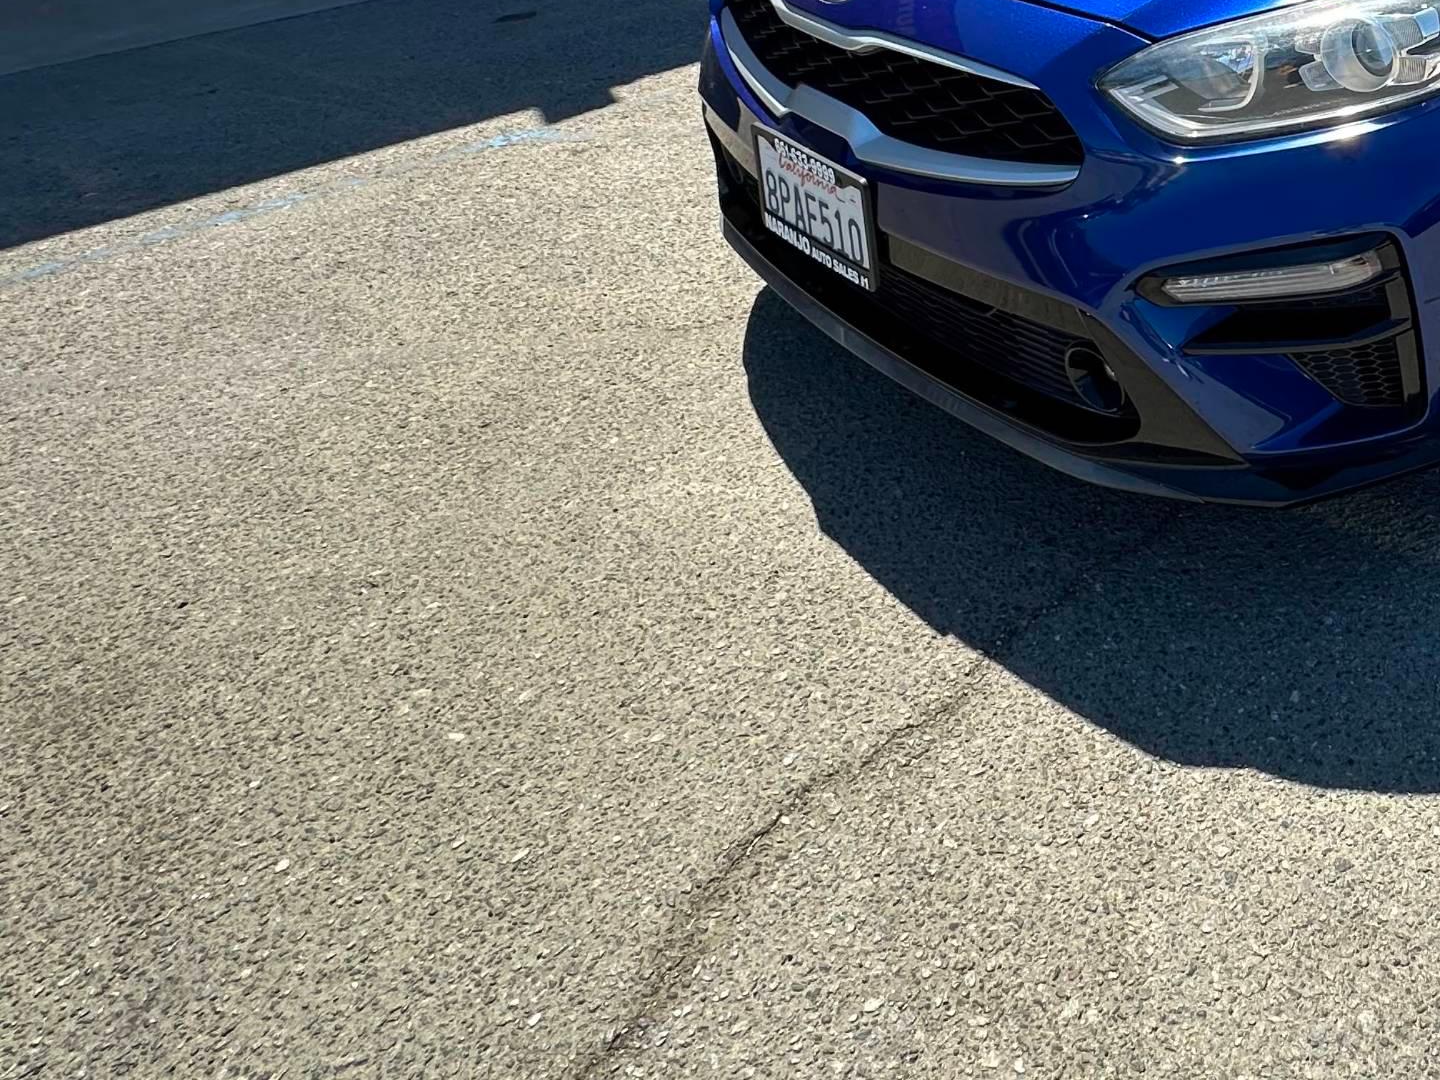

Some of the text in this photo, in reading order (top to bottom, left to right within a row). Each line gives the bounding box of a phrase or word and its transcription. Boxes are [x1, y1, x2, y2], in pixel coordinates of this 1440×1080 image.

[774, 137, 836, 184] 661-633-9999
[764, 211, 811, 255] NARANJO
[811, 246, 833, 269] AUTO
[832, 258, 860, 283] SALES
